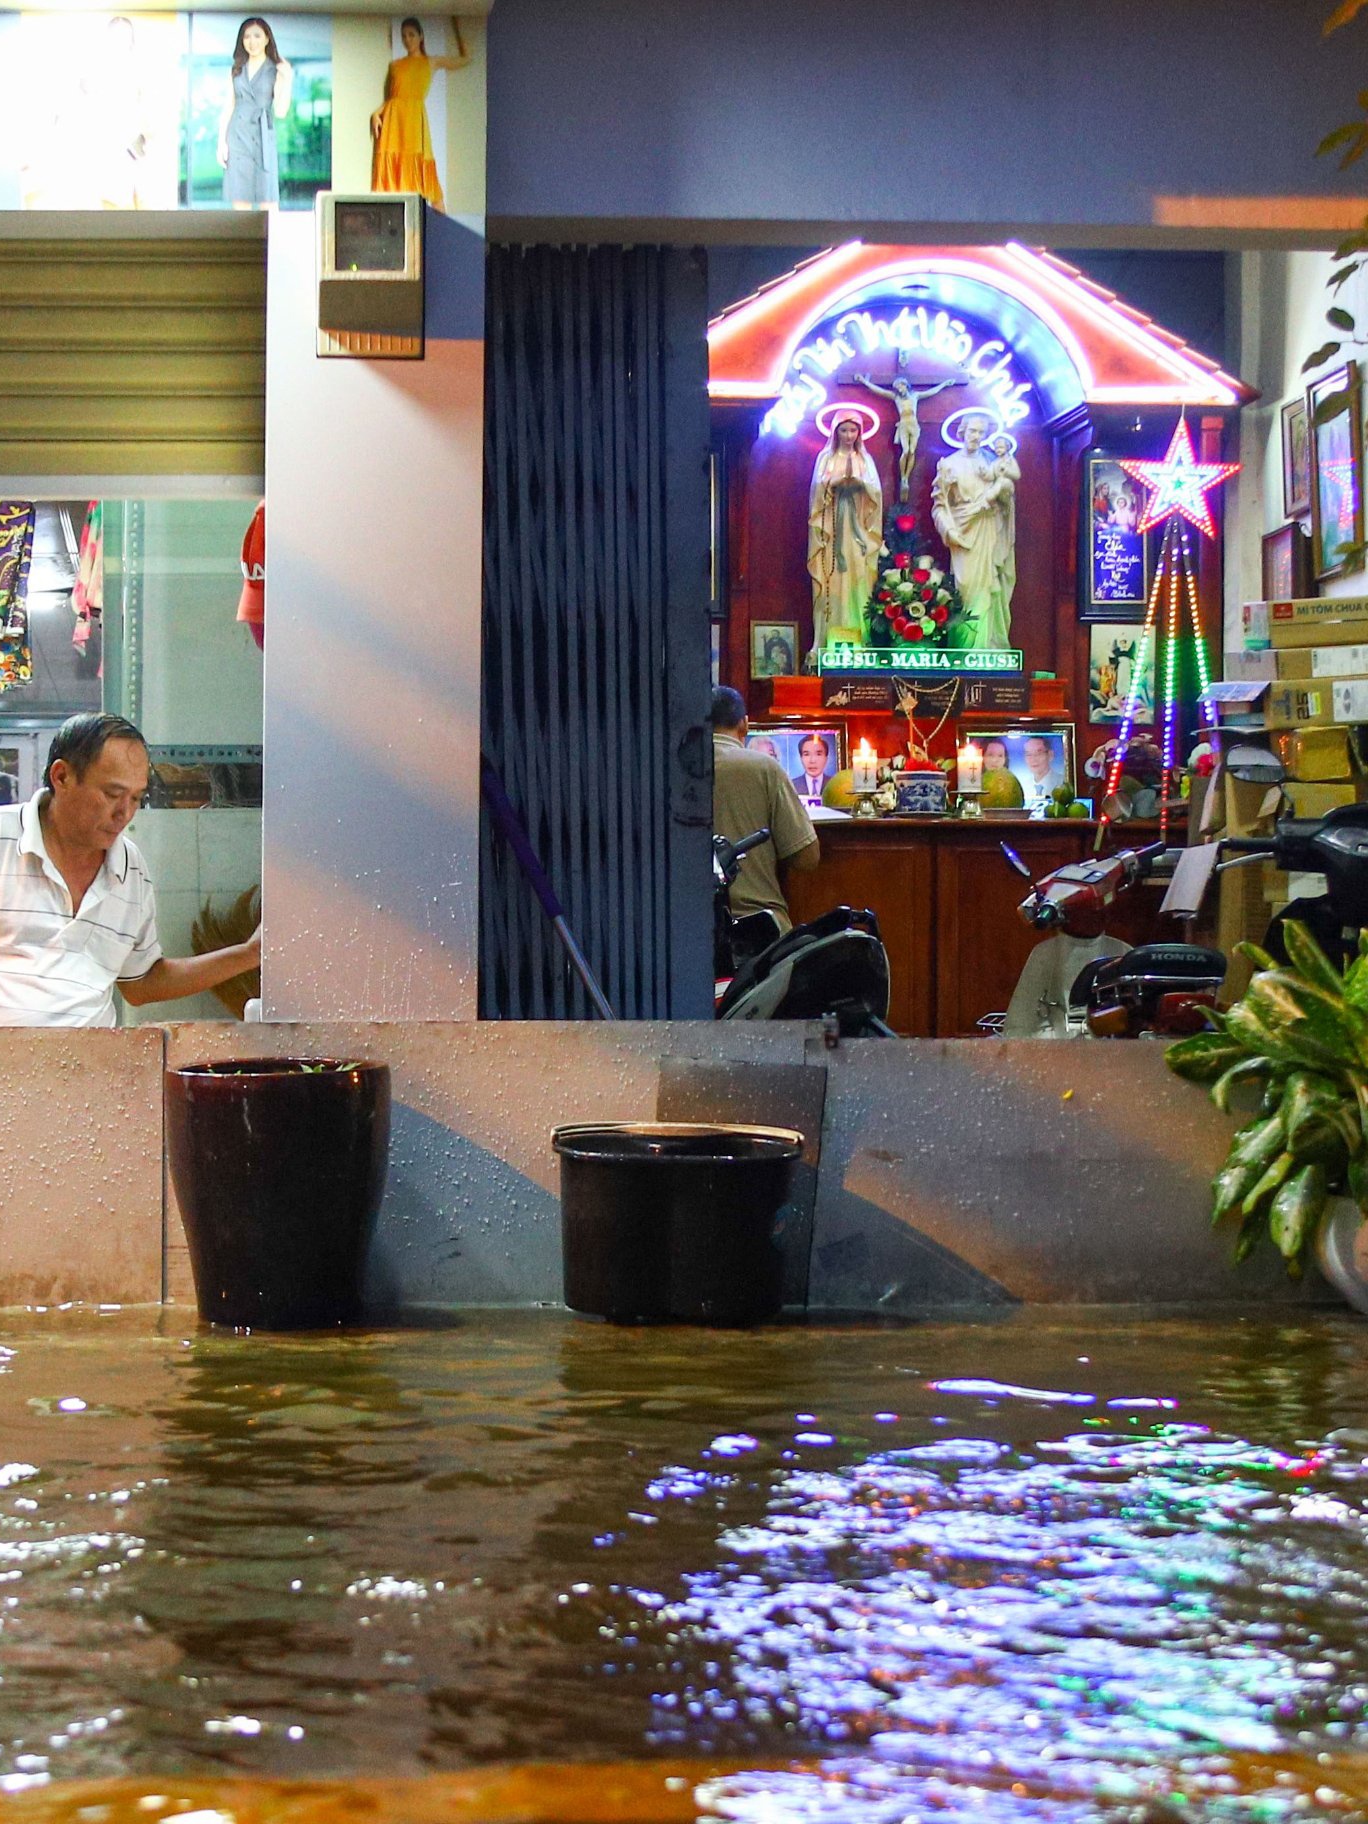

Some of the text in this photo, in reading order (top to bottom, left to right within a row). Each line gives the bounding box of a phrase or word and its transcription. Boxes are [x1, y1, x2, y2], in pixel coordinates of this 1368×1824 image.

[1335, 602, 1363, 613] CHUA
[891, 652, 951, 668] MARIA
[964, 653, 1019, 669] GIUSE
[1151, 953, 1207, 962] HONDA
